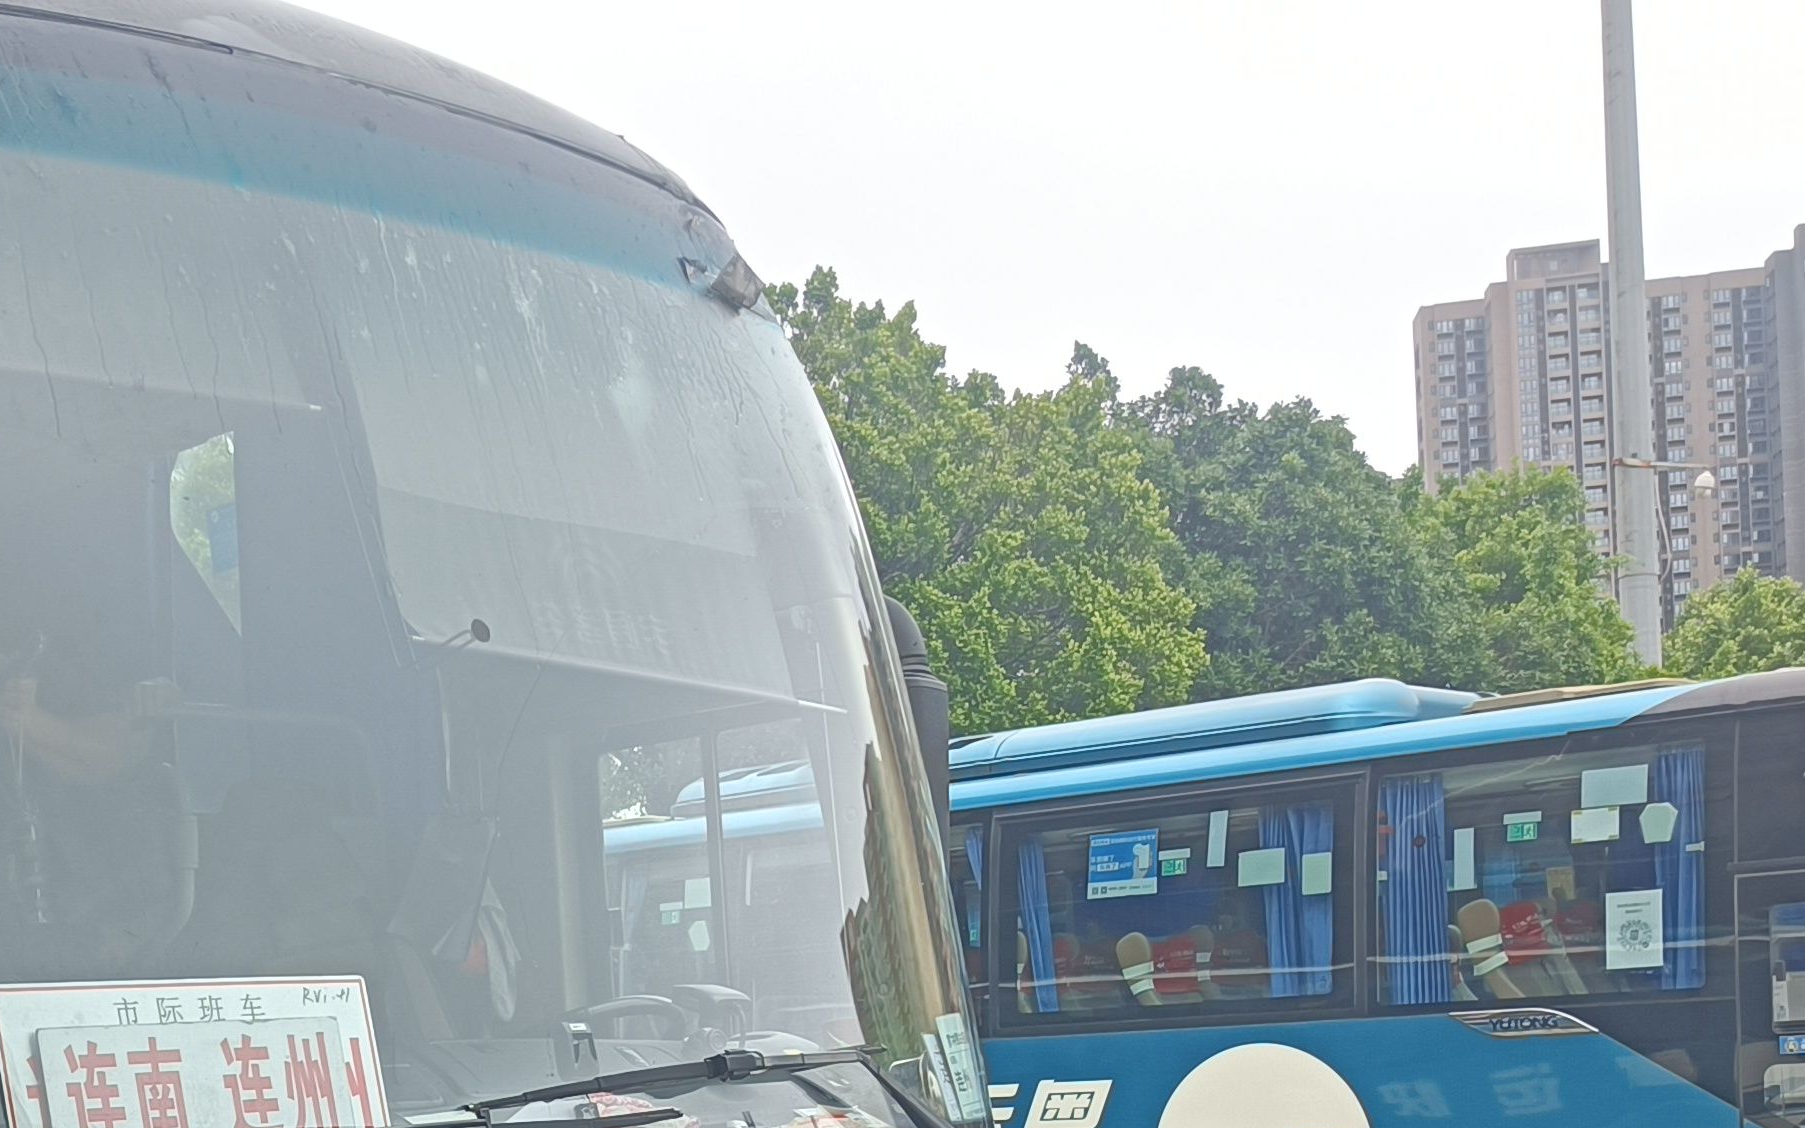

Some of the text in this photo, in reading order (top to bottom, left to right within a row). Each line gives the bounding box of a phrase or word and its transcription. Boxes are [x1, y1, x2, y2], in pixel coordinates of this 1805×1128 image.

[113, 993, 266, 1025] 市际班车
[1488, 1016, 1558, 1031] YUTONG
